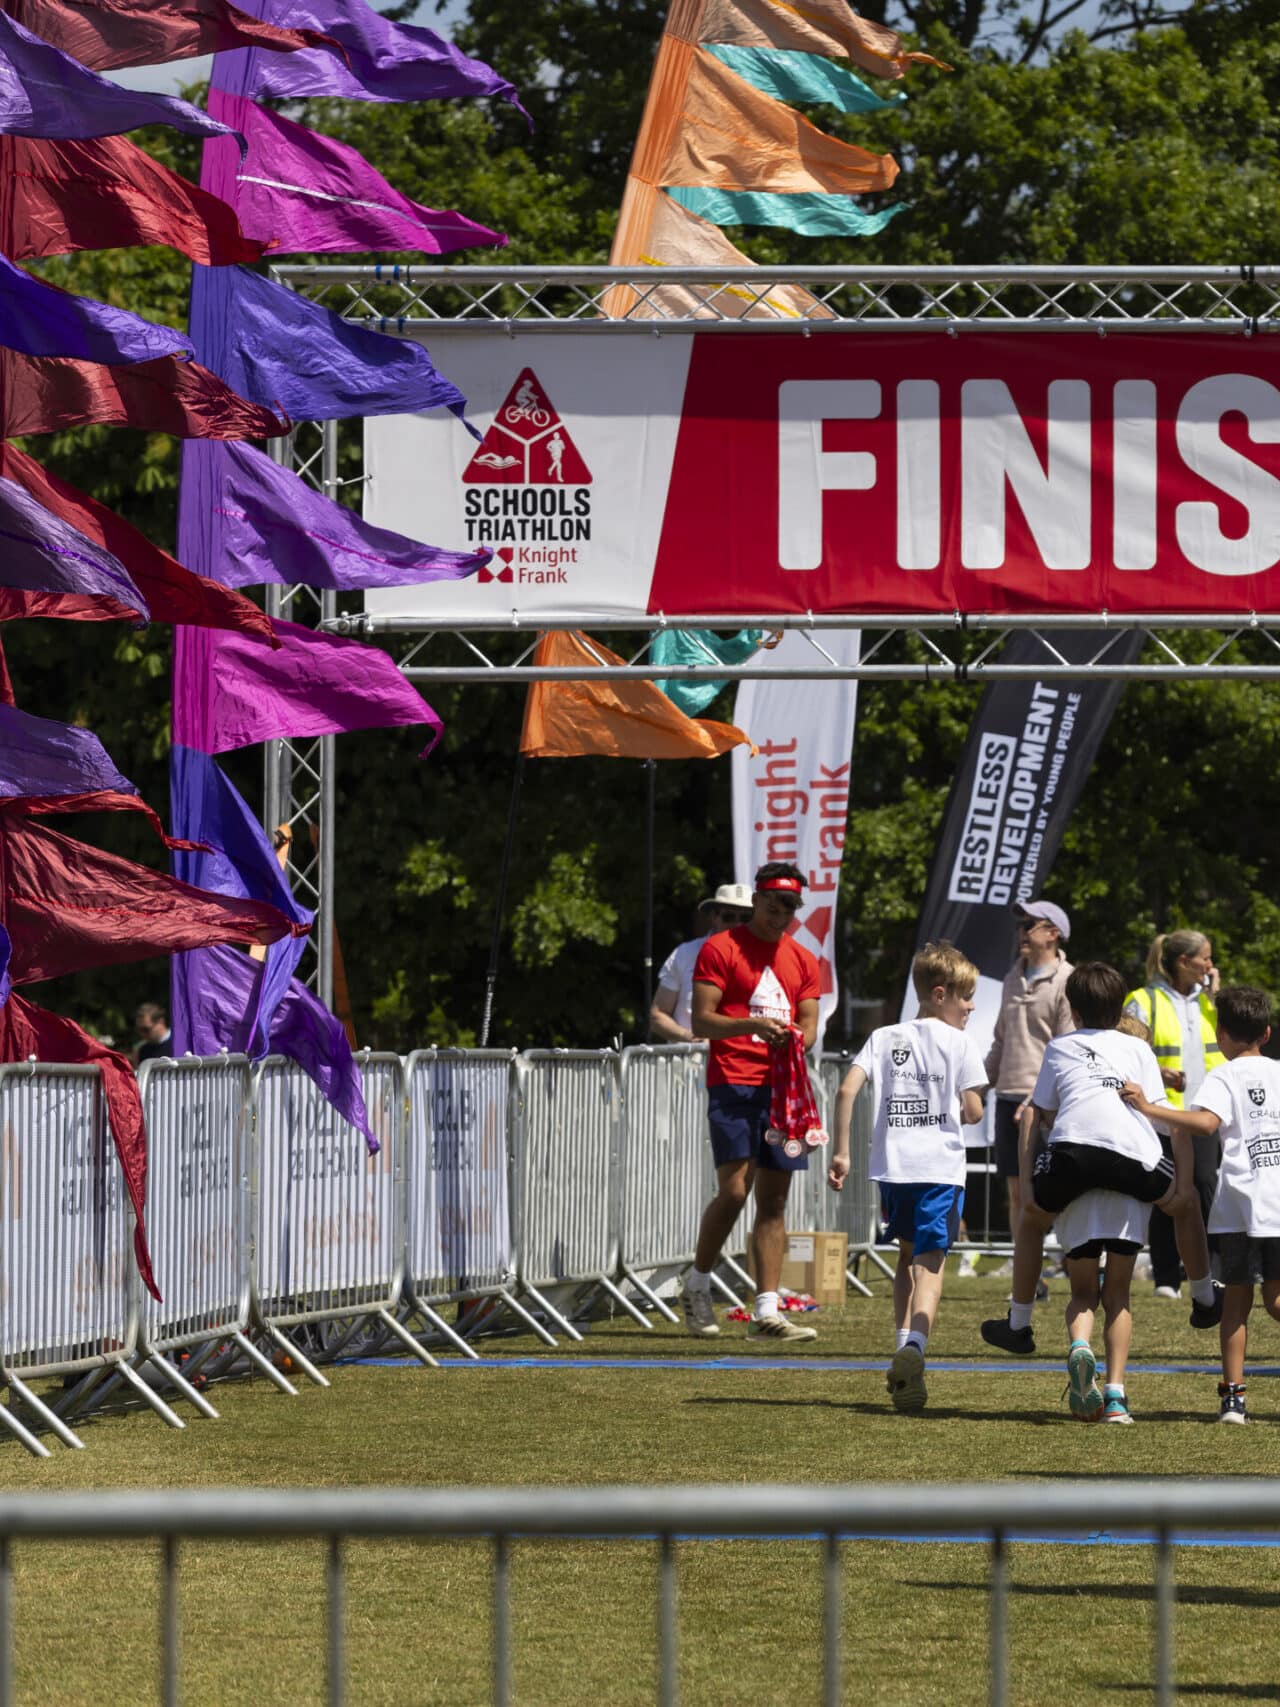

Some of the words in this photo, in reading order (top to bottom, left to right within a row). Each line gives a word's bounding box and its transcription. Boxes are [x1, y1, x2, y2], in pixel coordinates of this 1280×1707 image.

[465, 488, 591, 517] SCHOOLS
[465, 517, 591, 541] TRIATHLON
[518, 545, 578, 567] Knight
[518, 566, 569, 584] Frank
[755, 737, 810, 869] night
[987, 681, 1060, 906] DEVELOPMENT
[1016, 832, 1044, 904] POWERED
[1035, 808, 1050, 830] BY
[1043, 753, 1066, 803] YOUNG
[1056, 692, 1082, 751] PEOPLE
[809, 761, 850, 892] Frank
[957, 740, 1010, 896] RESTLESS
[887, 1101, 928, 1114] STLESS
[887, 1113, 948, 1128] VELOPMENT
